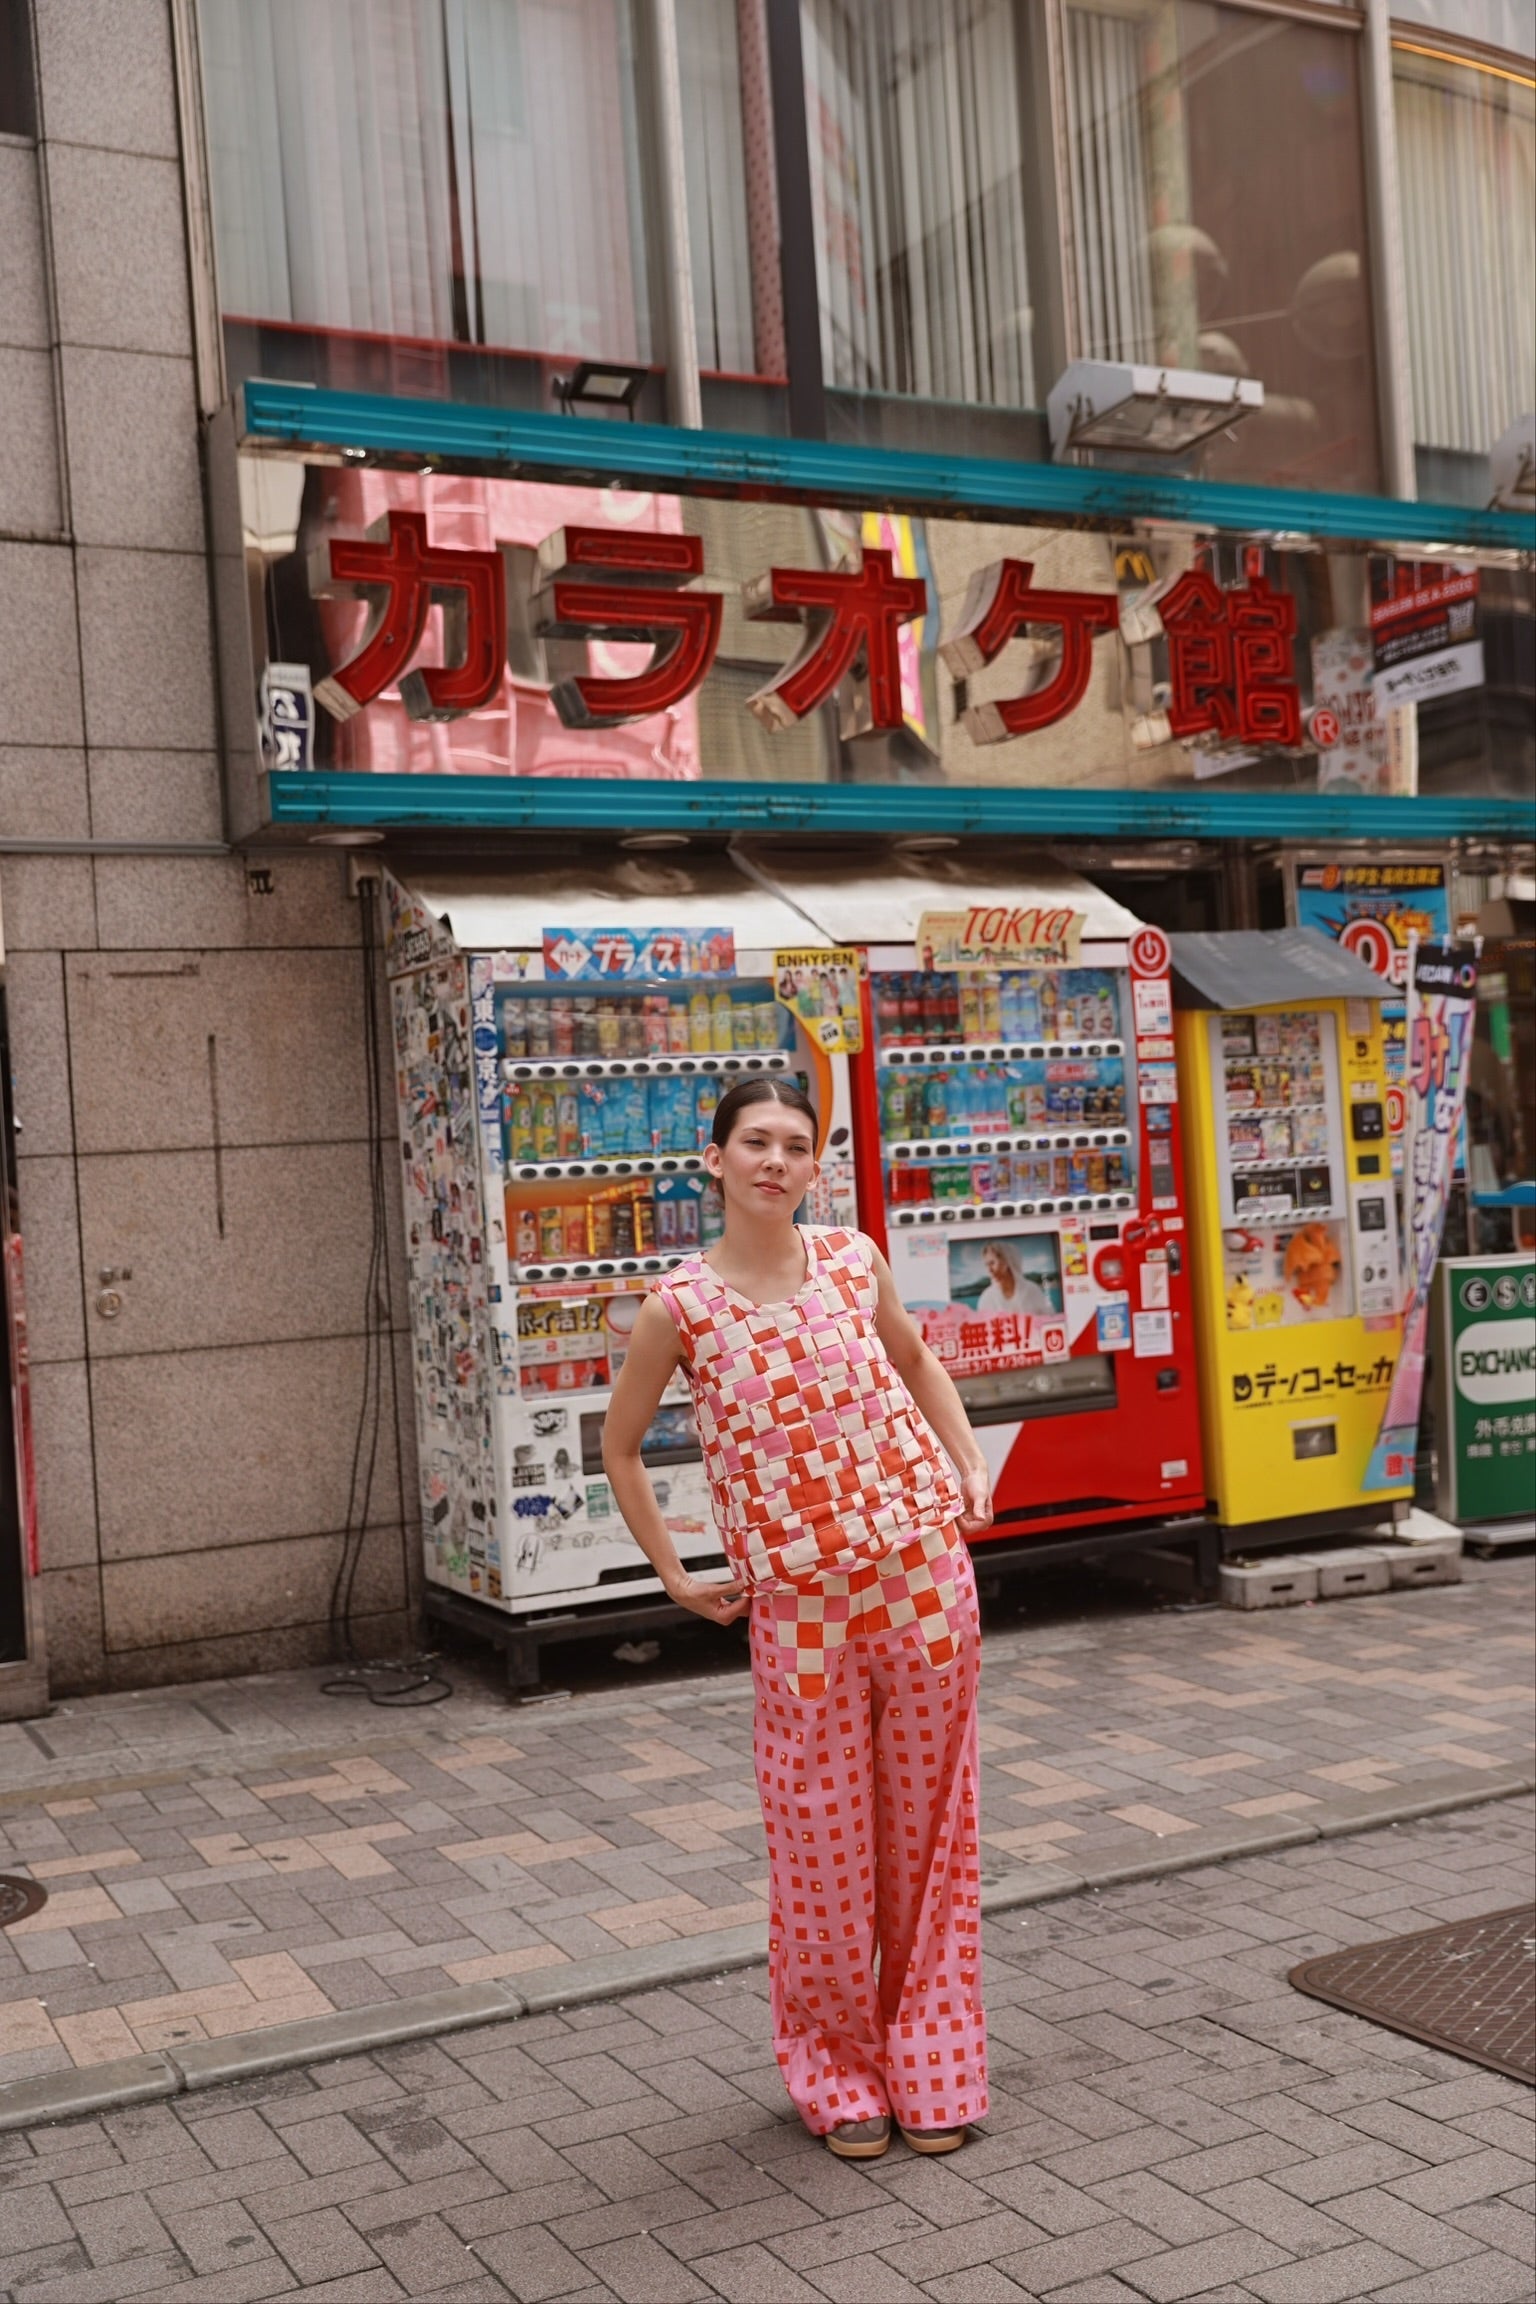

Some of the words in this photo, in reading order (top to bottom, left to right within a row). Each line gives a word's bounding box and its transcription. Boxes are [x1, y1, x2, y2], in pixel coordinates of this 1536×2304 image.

[328, 510, 1302, 748] カラオケ館
[963, 906, 1075, 945] TOKYO
[776, 952, 854, 967] ENHYPEN
